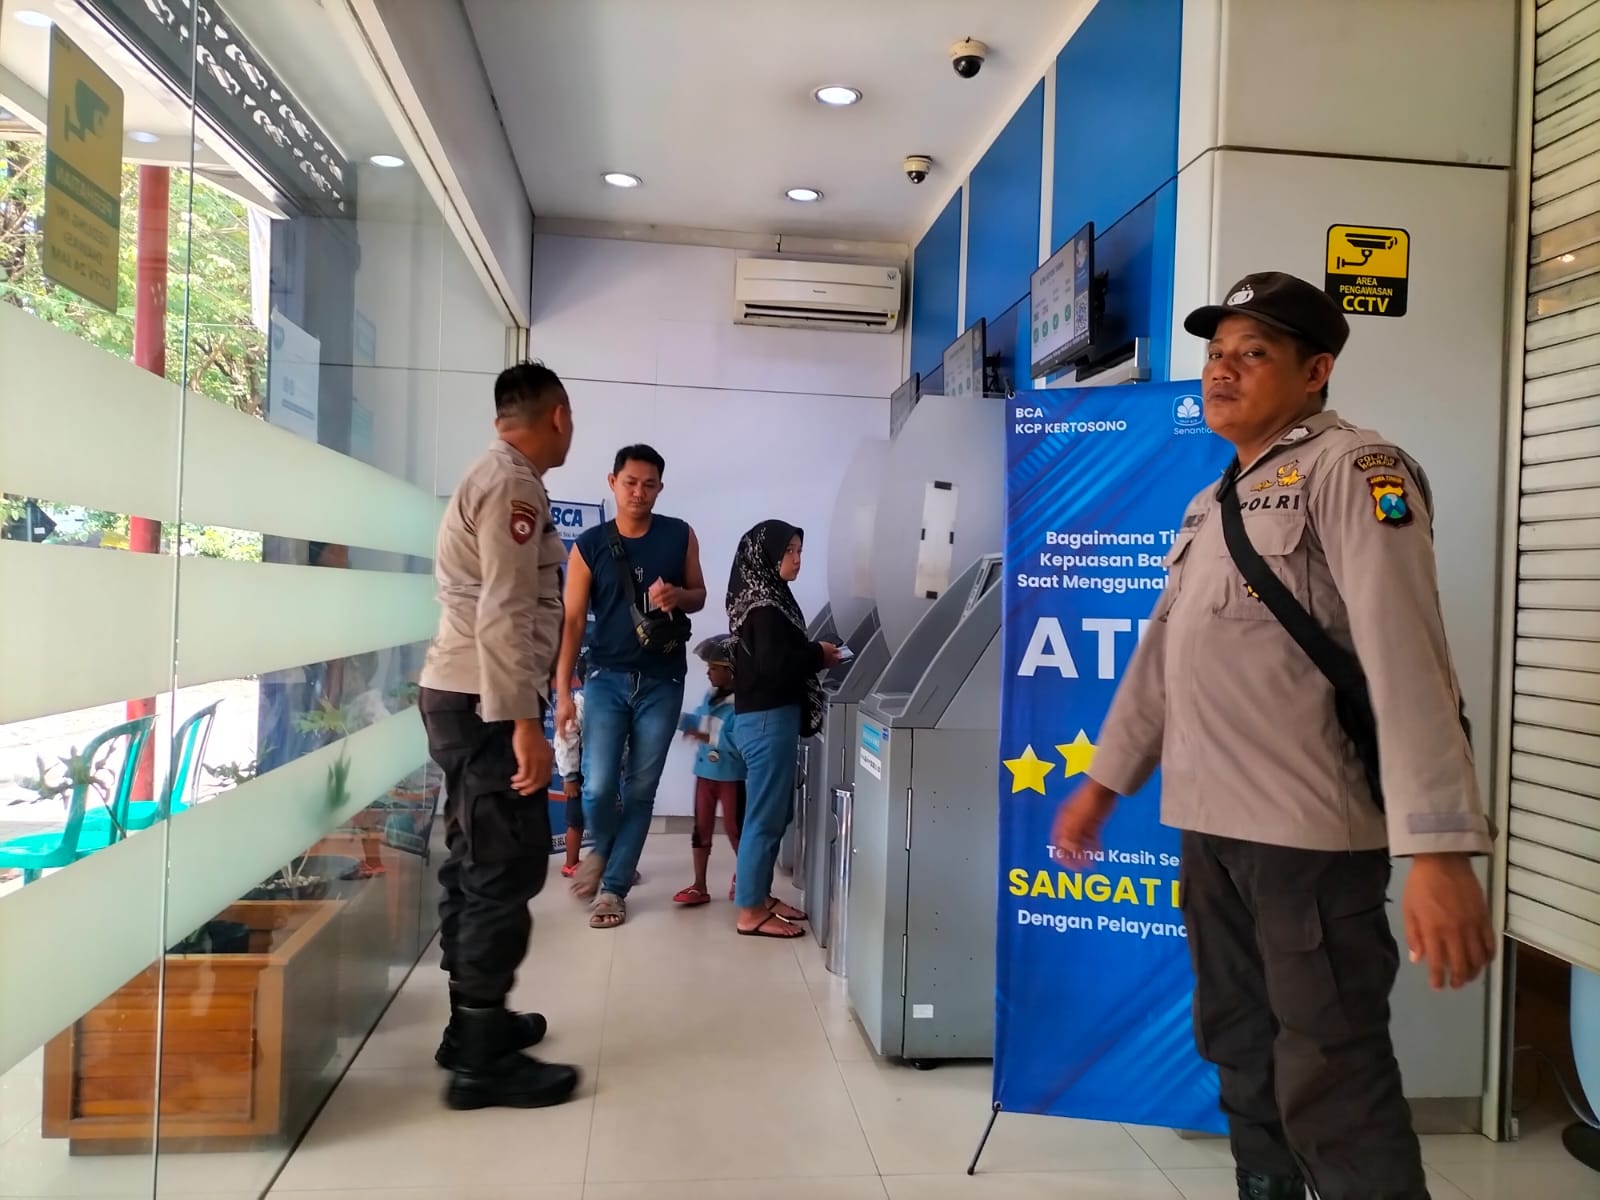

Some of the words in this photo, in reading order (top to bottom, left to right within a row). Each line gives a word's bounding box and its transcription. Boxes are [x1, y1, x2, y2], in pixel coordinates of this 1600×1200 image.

[1356, 276, 1378, 286] AREA
[1339, 284, 1393, 297] PENGAWASAN
[1342, 295, 1389, 313] CCTV
[1015, 407, 1044, 419] BCA
[1015, 423, 1042, 434] KCP
[1045, 420, 1127, 433] KERTOSONO
[1173, 426, 1213, 436] Senantia
[551, 507, 583, 527] BCA
[1046, 530, 1154, 548] Bagaimana
[1158, 529, 1179, 545] Ti
[1040, 553, 1134, 571] Kepuasan
[1017, 573, 1059, 588] Saat
[1017, 616, 1152, 680] AT
[1046, 845, 1104, 862] Teima
[1108, 849, 1156, 866] Kasih
[1159, 853, 1182, 867] Se
[1009, 869, 1161, 906] SANGAT
[1018, 909, 1093, 933] Dengan
[1097, 915, 1188, 940] Pelayana
